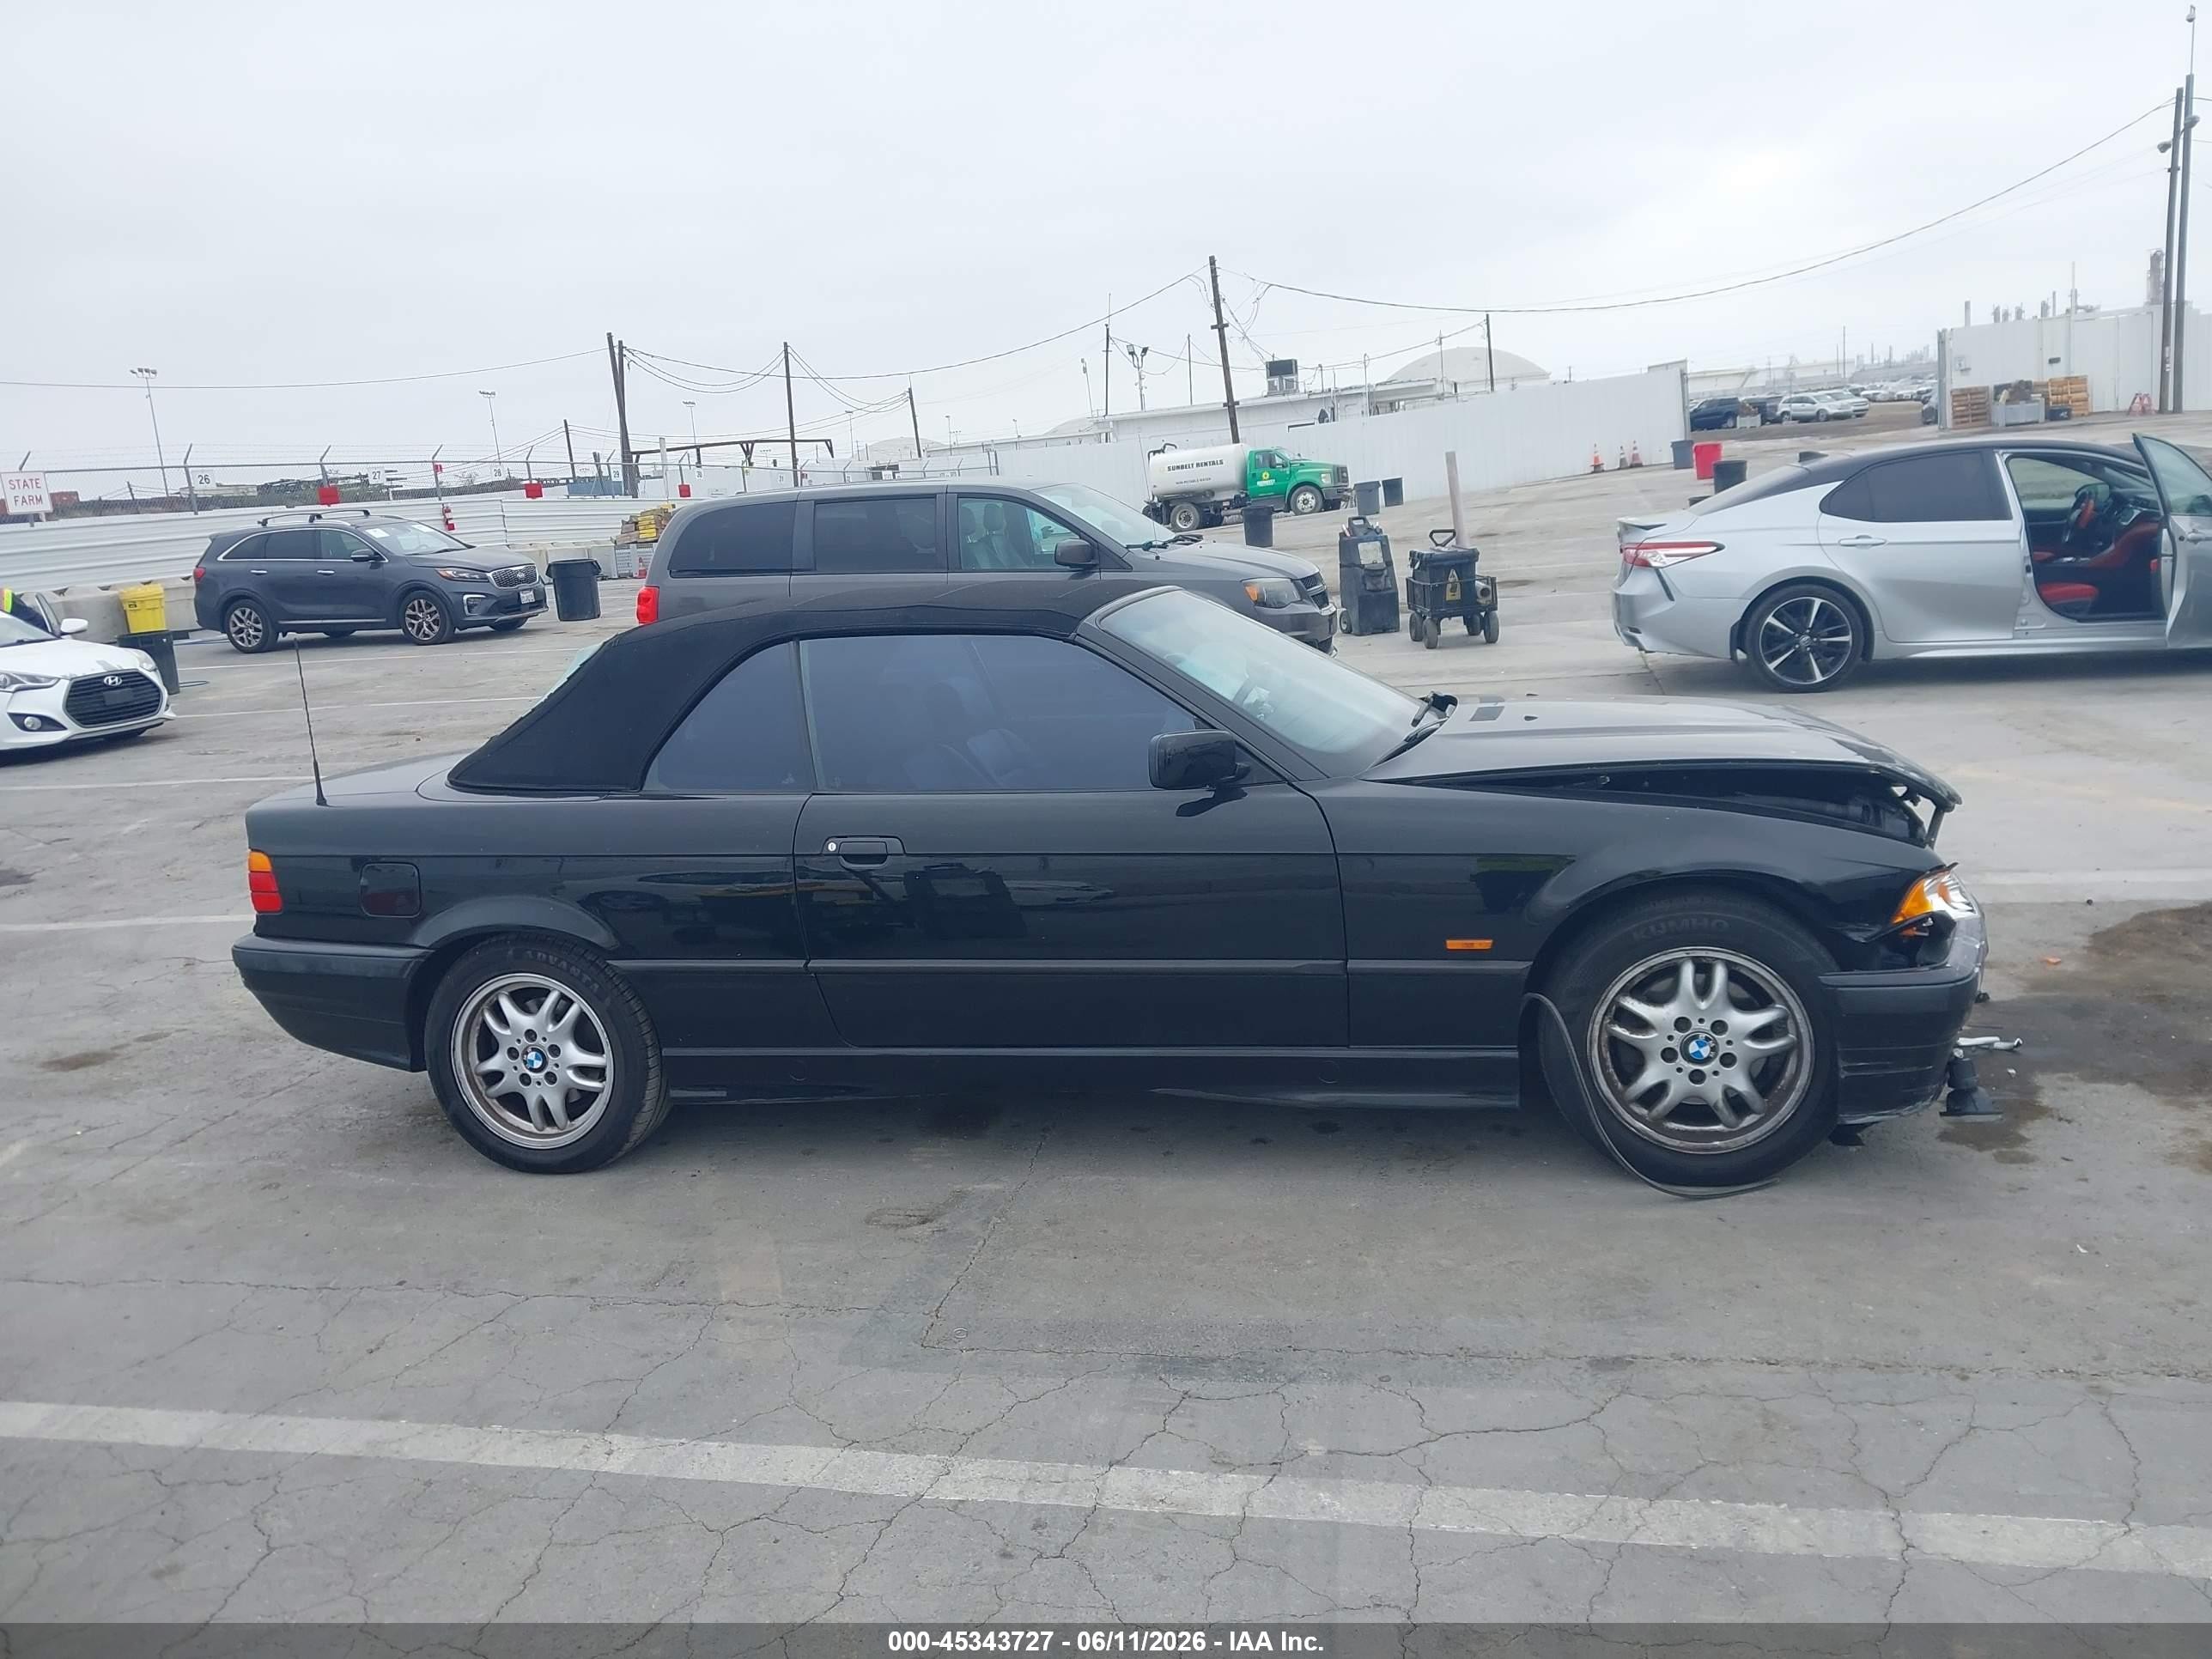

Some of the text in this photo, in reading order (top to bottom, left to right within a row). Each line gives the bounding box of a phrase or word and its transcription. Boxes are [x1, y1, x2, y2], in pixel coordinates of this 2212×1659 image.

[1167, 459, 1224, 472] SUNBELT RENTALS
[198, 474, 210, 484] 26
[372, 471, 381, 480] 27
[494, 468, 502, 477] 28
[612, 470, 620, 478] 29
[8, 477, 42, 490] STATE
[14, 494, 43, 507] FARM
[1632, 919, 1729, 942] KUMHO
[526, 951, 599, 994] ADVANTA
